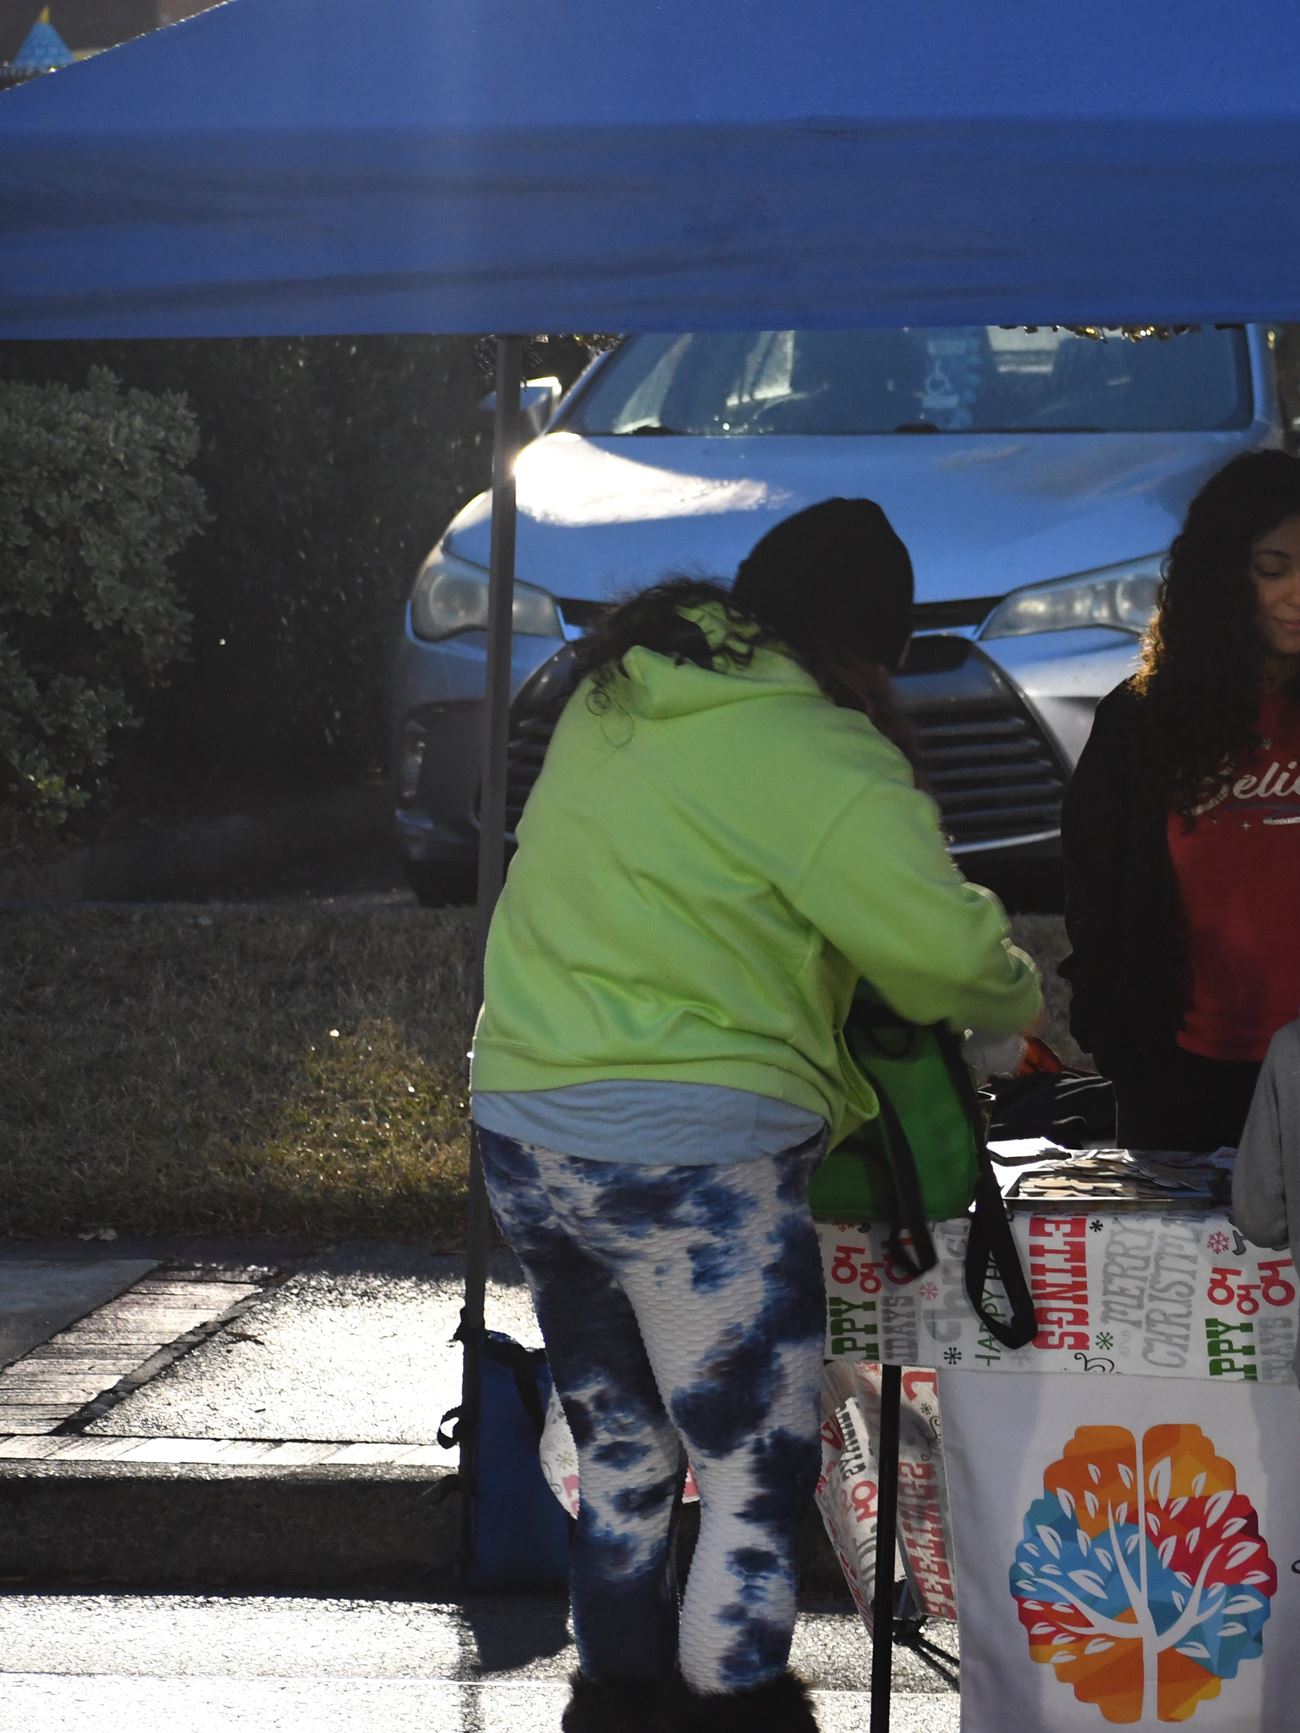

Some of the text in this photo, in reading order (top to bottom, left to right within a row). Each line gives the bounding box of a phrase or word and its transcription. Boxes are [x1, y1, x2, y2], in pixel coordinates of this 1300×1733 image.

[1028, 1215, 1090, 1351] ETINGS
[829, 1297, 880, 1361] PPY
[1205, 1318, 1258, 1381] PPY
